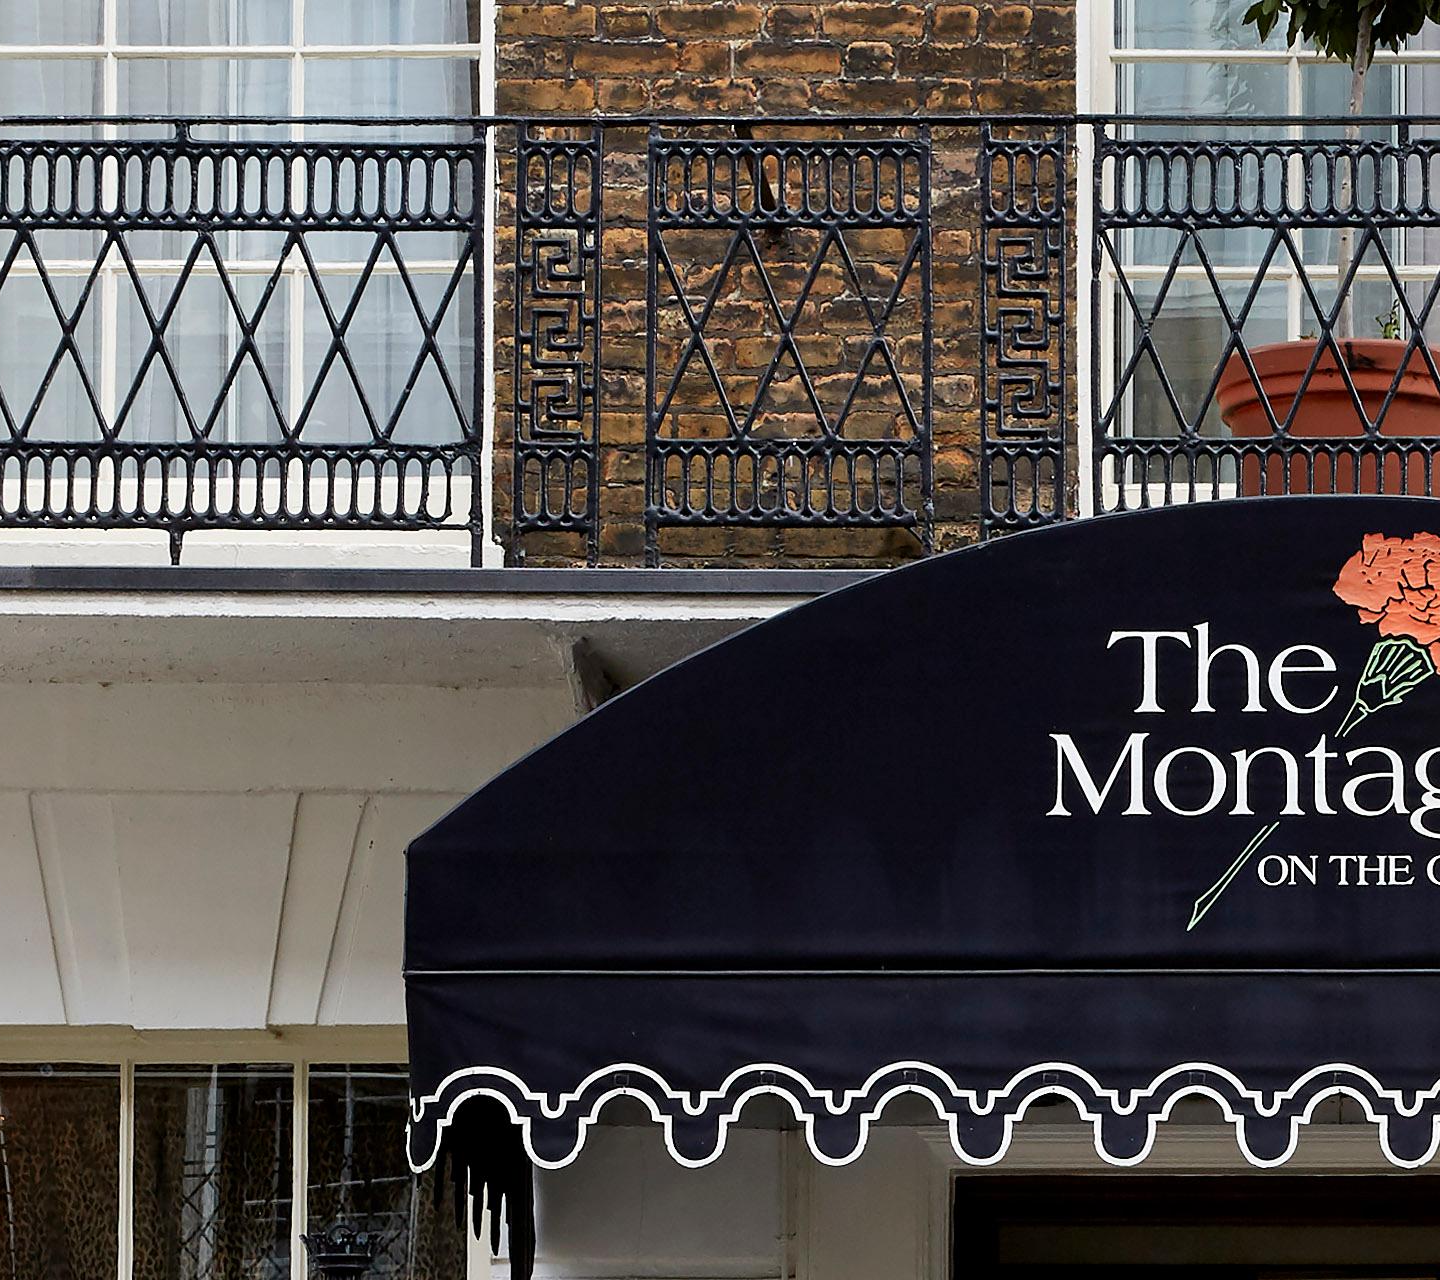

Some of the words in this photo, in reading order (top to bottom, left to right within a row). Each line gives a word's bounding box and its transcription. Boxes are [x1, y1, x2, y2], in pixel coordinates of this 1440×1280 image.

[1106, 622, 1338, 715] The
[1257, 854, 1317, 888] ON
[1328, 854, 1414, 887] THE
